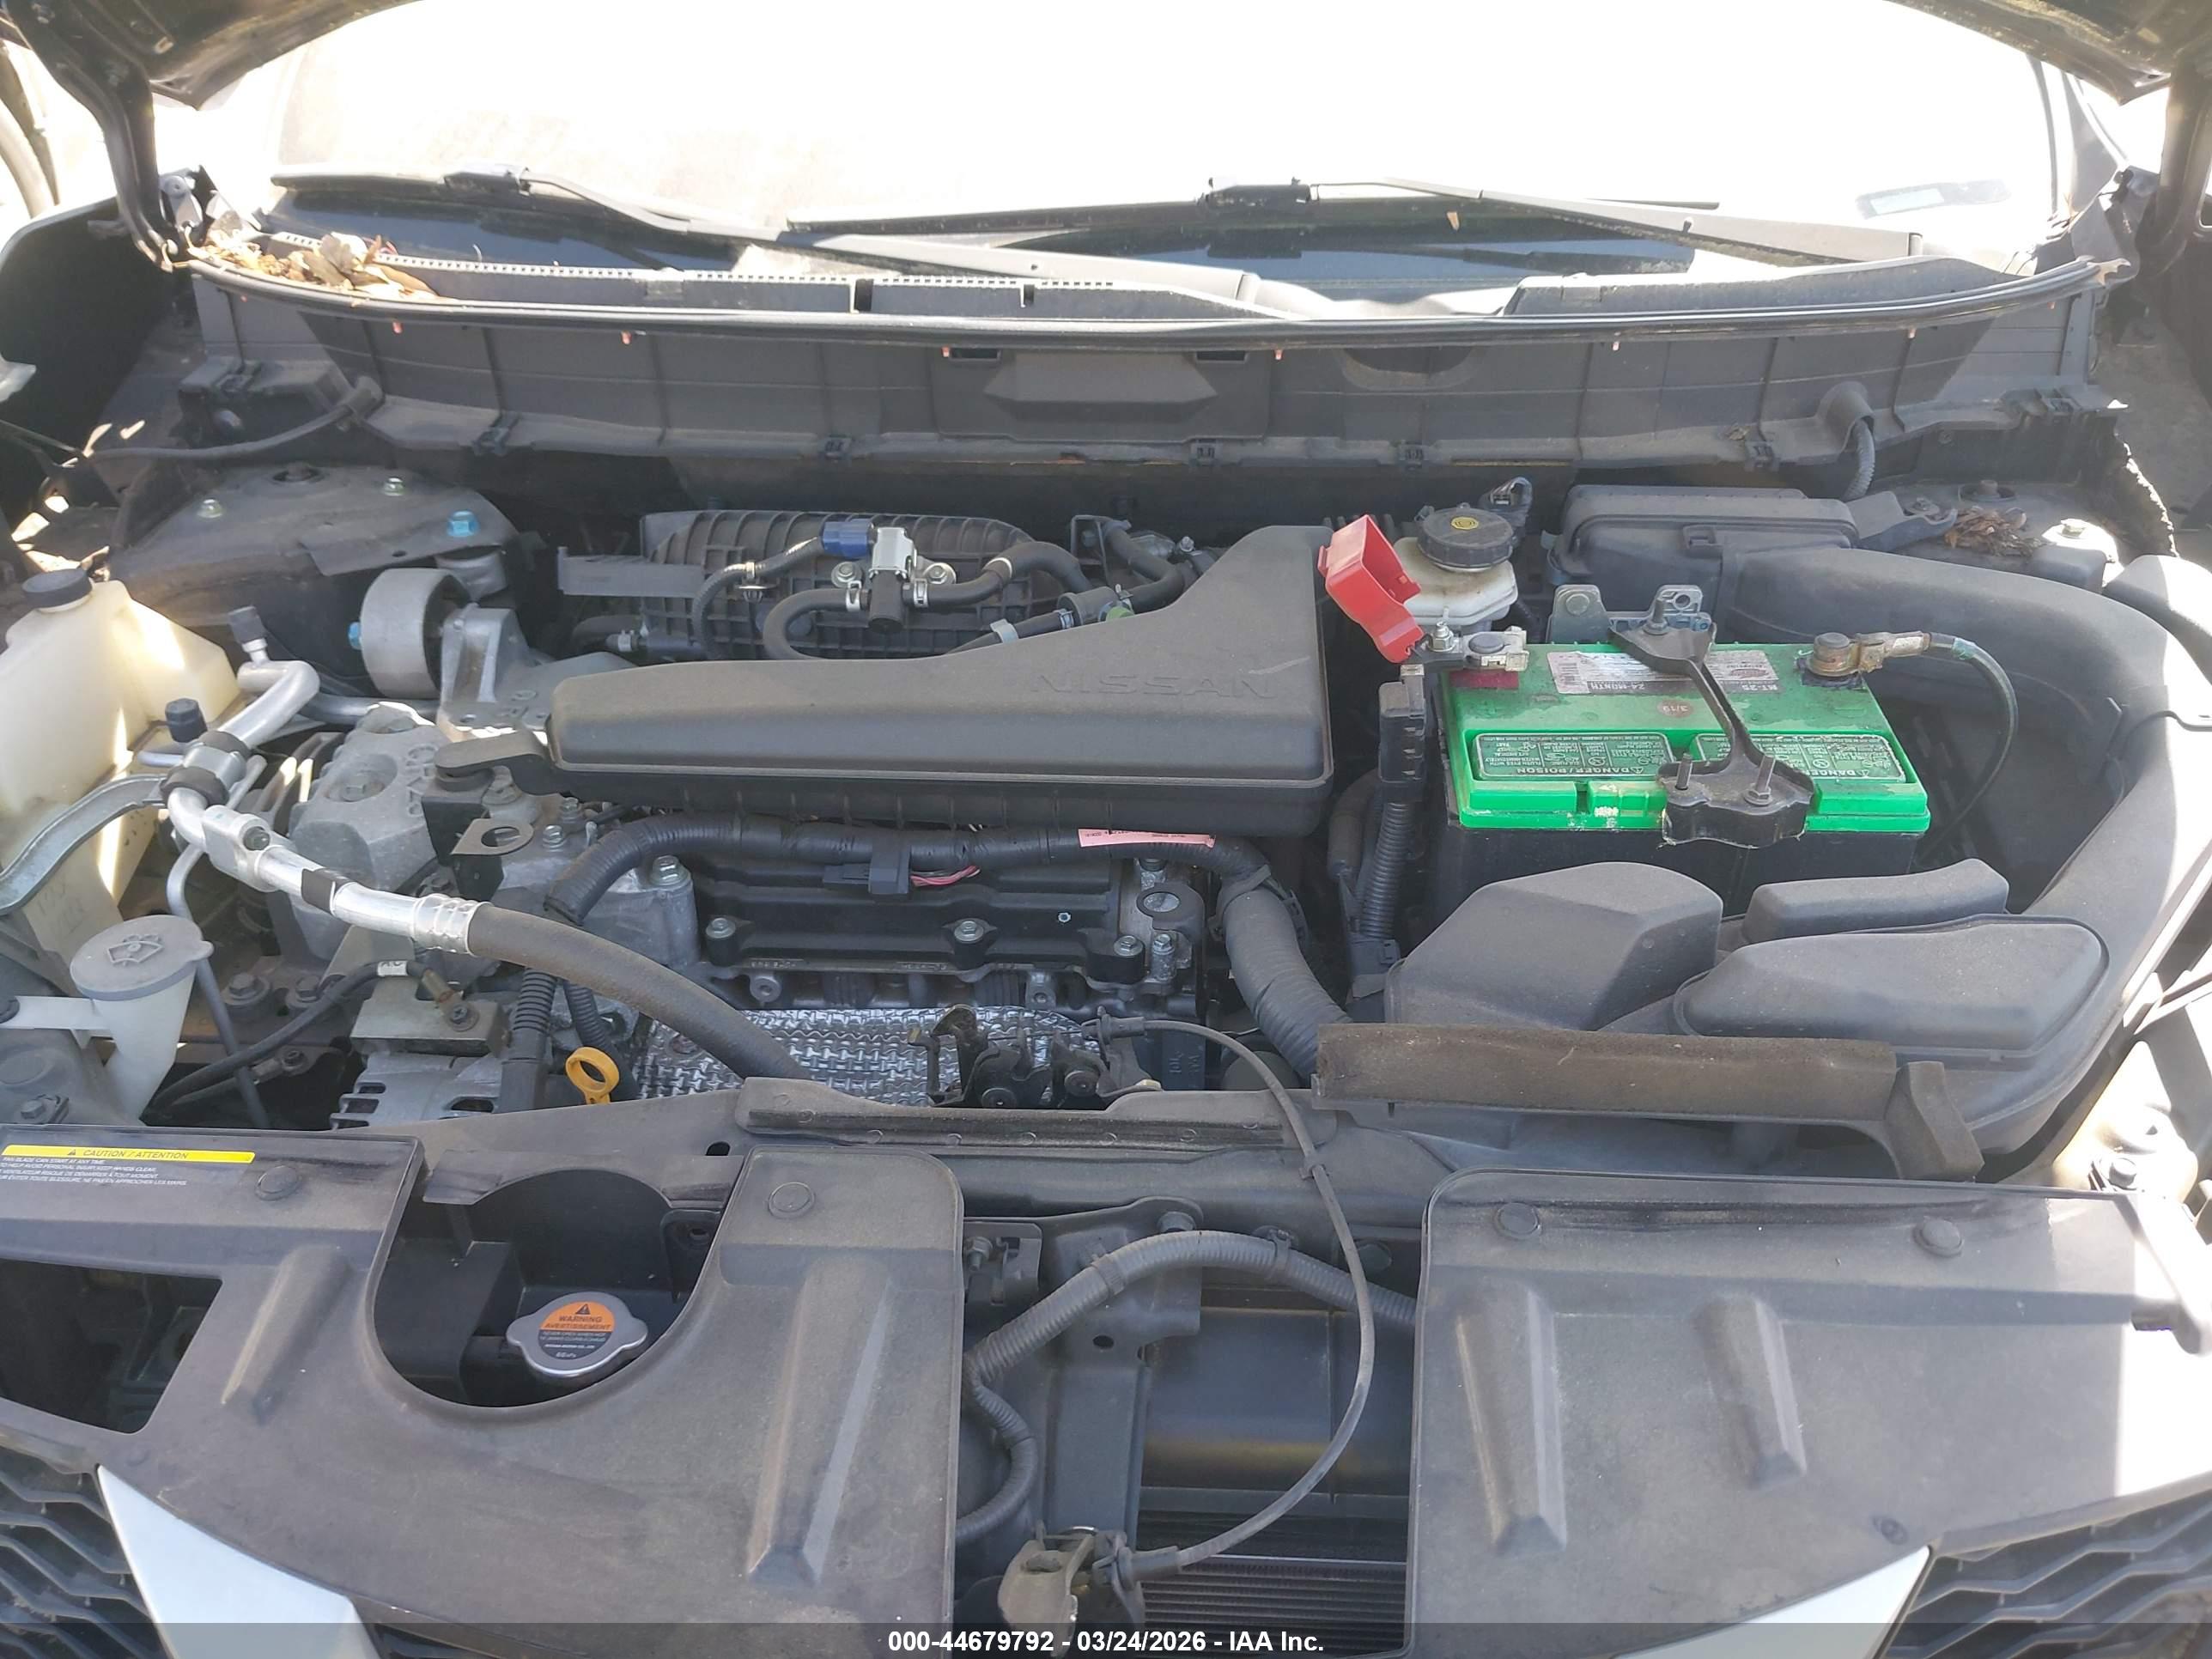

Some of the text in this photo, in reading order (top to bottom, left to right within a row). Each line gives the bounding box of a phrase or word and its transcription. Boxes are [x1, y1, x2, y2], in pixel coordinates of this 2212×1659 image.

[1032, 675, 1278, 699] NISSAN
[83, 1149, 125, 1158] CAUTION
[137, 1152, 188, 1160] ATTENTION
